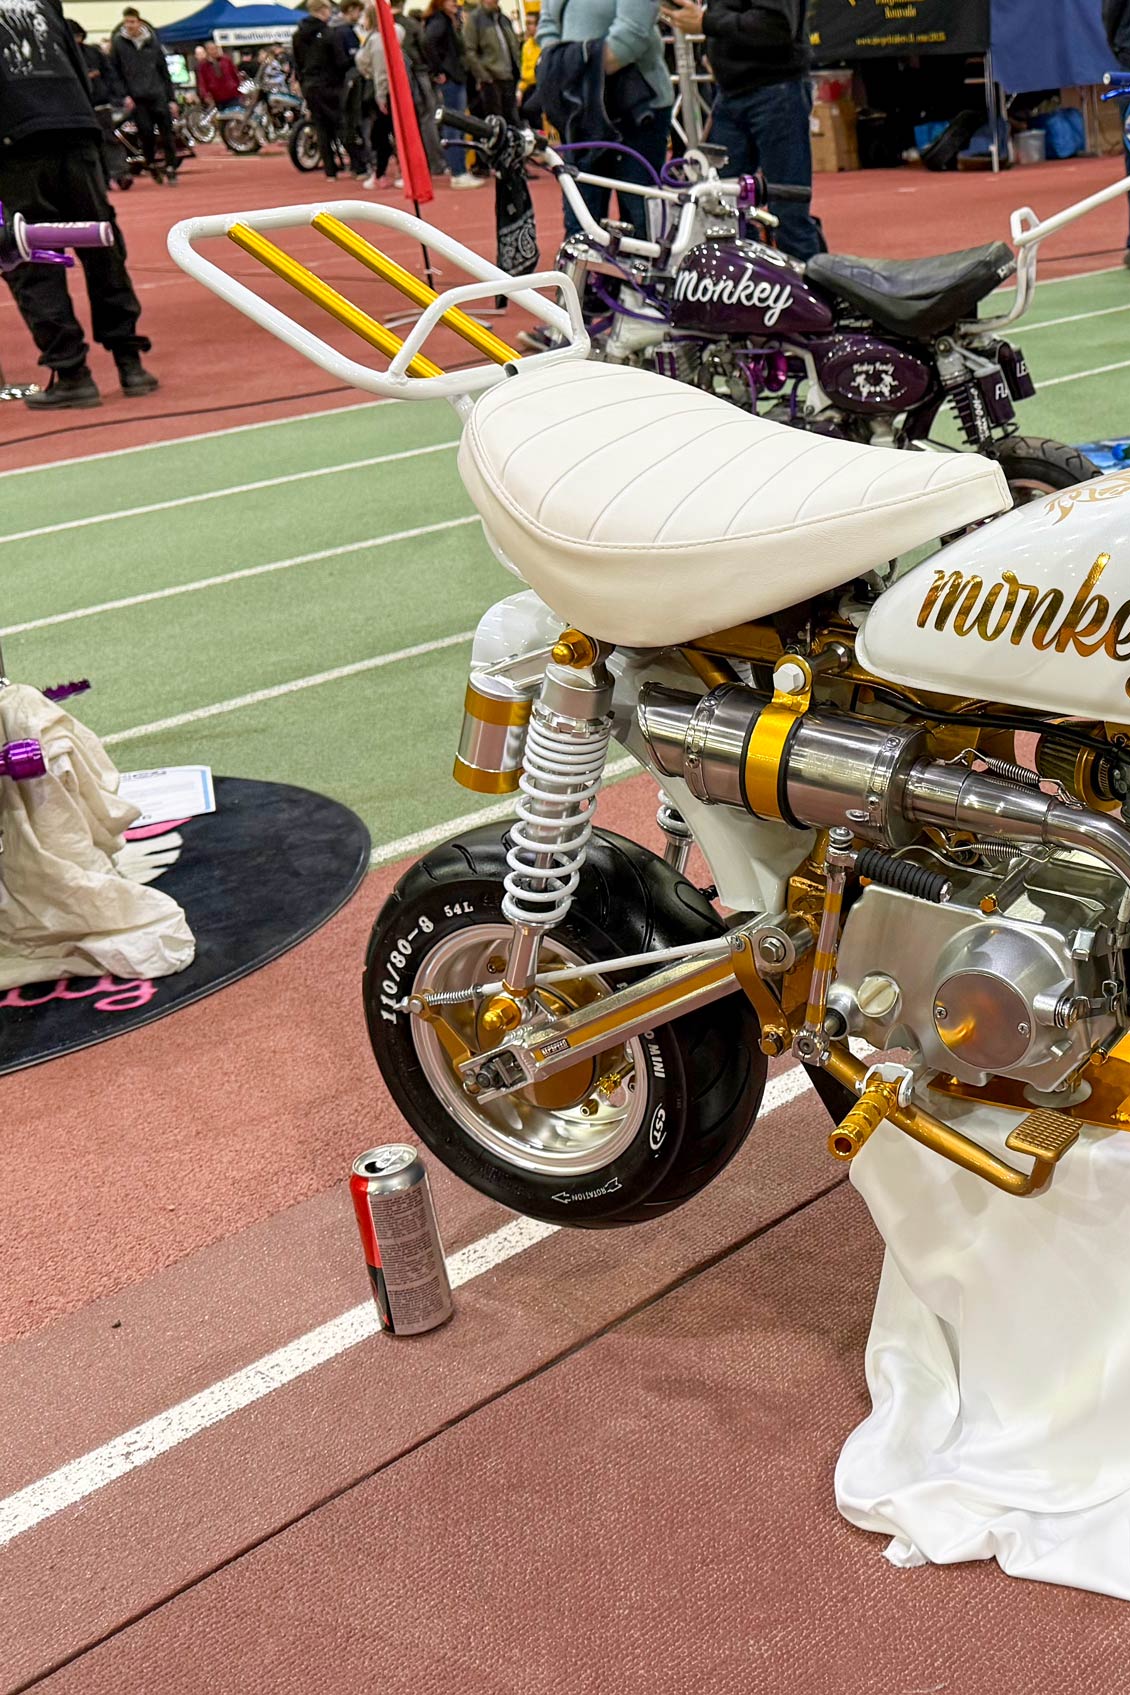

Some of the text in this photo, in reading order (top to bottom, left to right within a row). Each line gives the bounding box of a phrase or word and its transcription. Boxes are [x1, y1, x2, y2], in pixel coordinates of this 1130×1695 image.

[444, 901, 474, 917] 54L
[648, 1043, 666, 1078] MINI
[653, 1106, 667, 1145] CST
[571, 1187, 607, 1201] ROTATION
